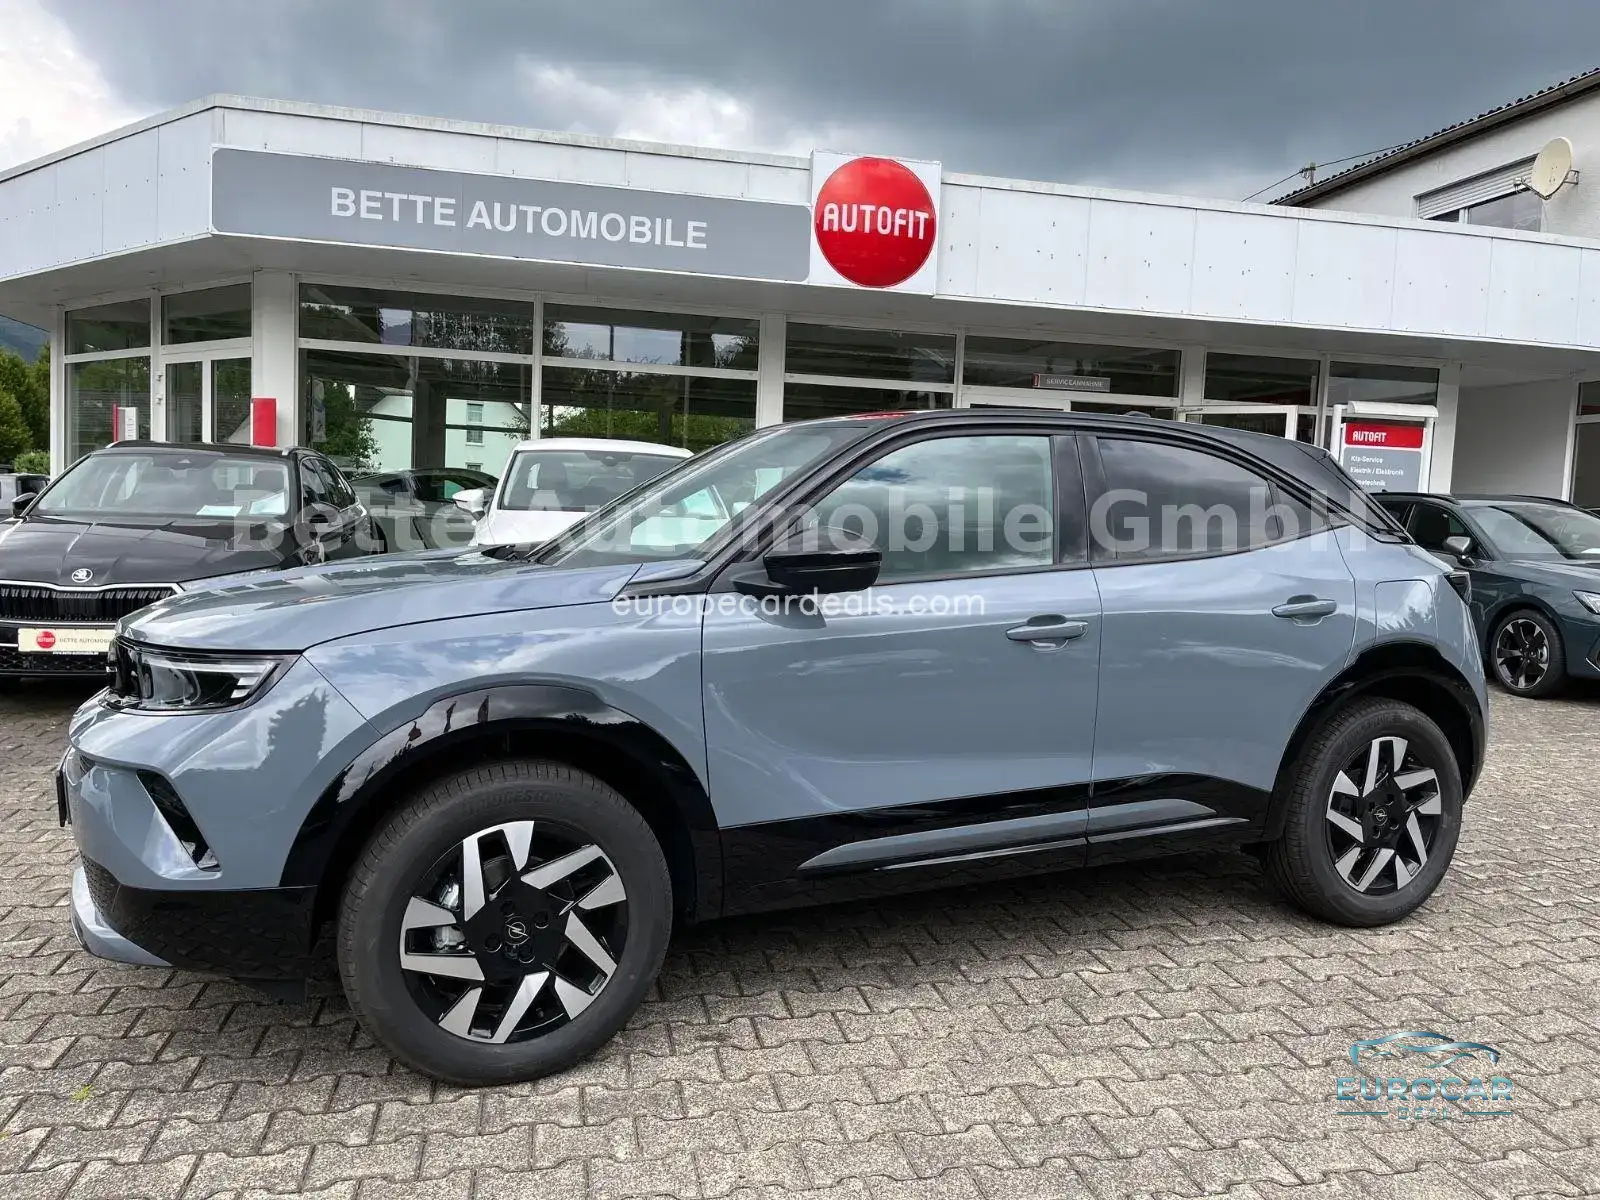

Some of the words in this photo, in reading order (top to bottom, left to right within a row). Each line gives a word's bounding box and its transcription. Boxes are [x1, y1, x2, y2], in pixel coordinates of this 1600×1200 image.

[330, 187, 456, 227] BETTE
[466, 200, 708, 249] AUTOMOBILE
[822, 202, 930, 240] AUTOFIT
[1353, 431, 1387, 442] AUTOFIT
